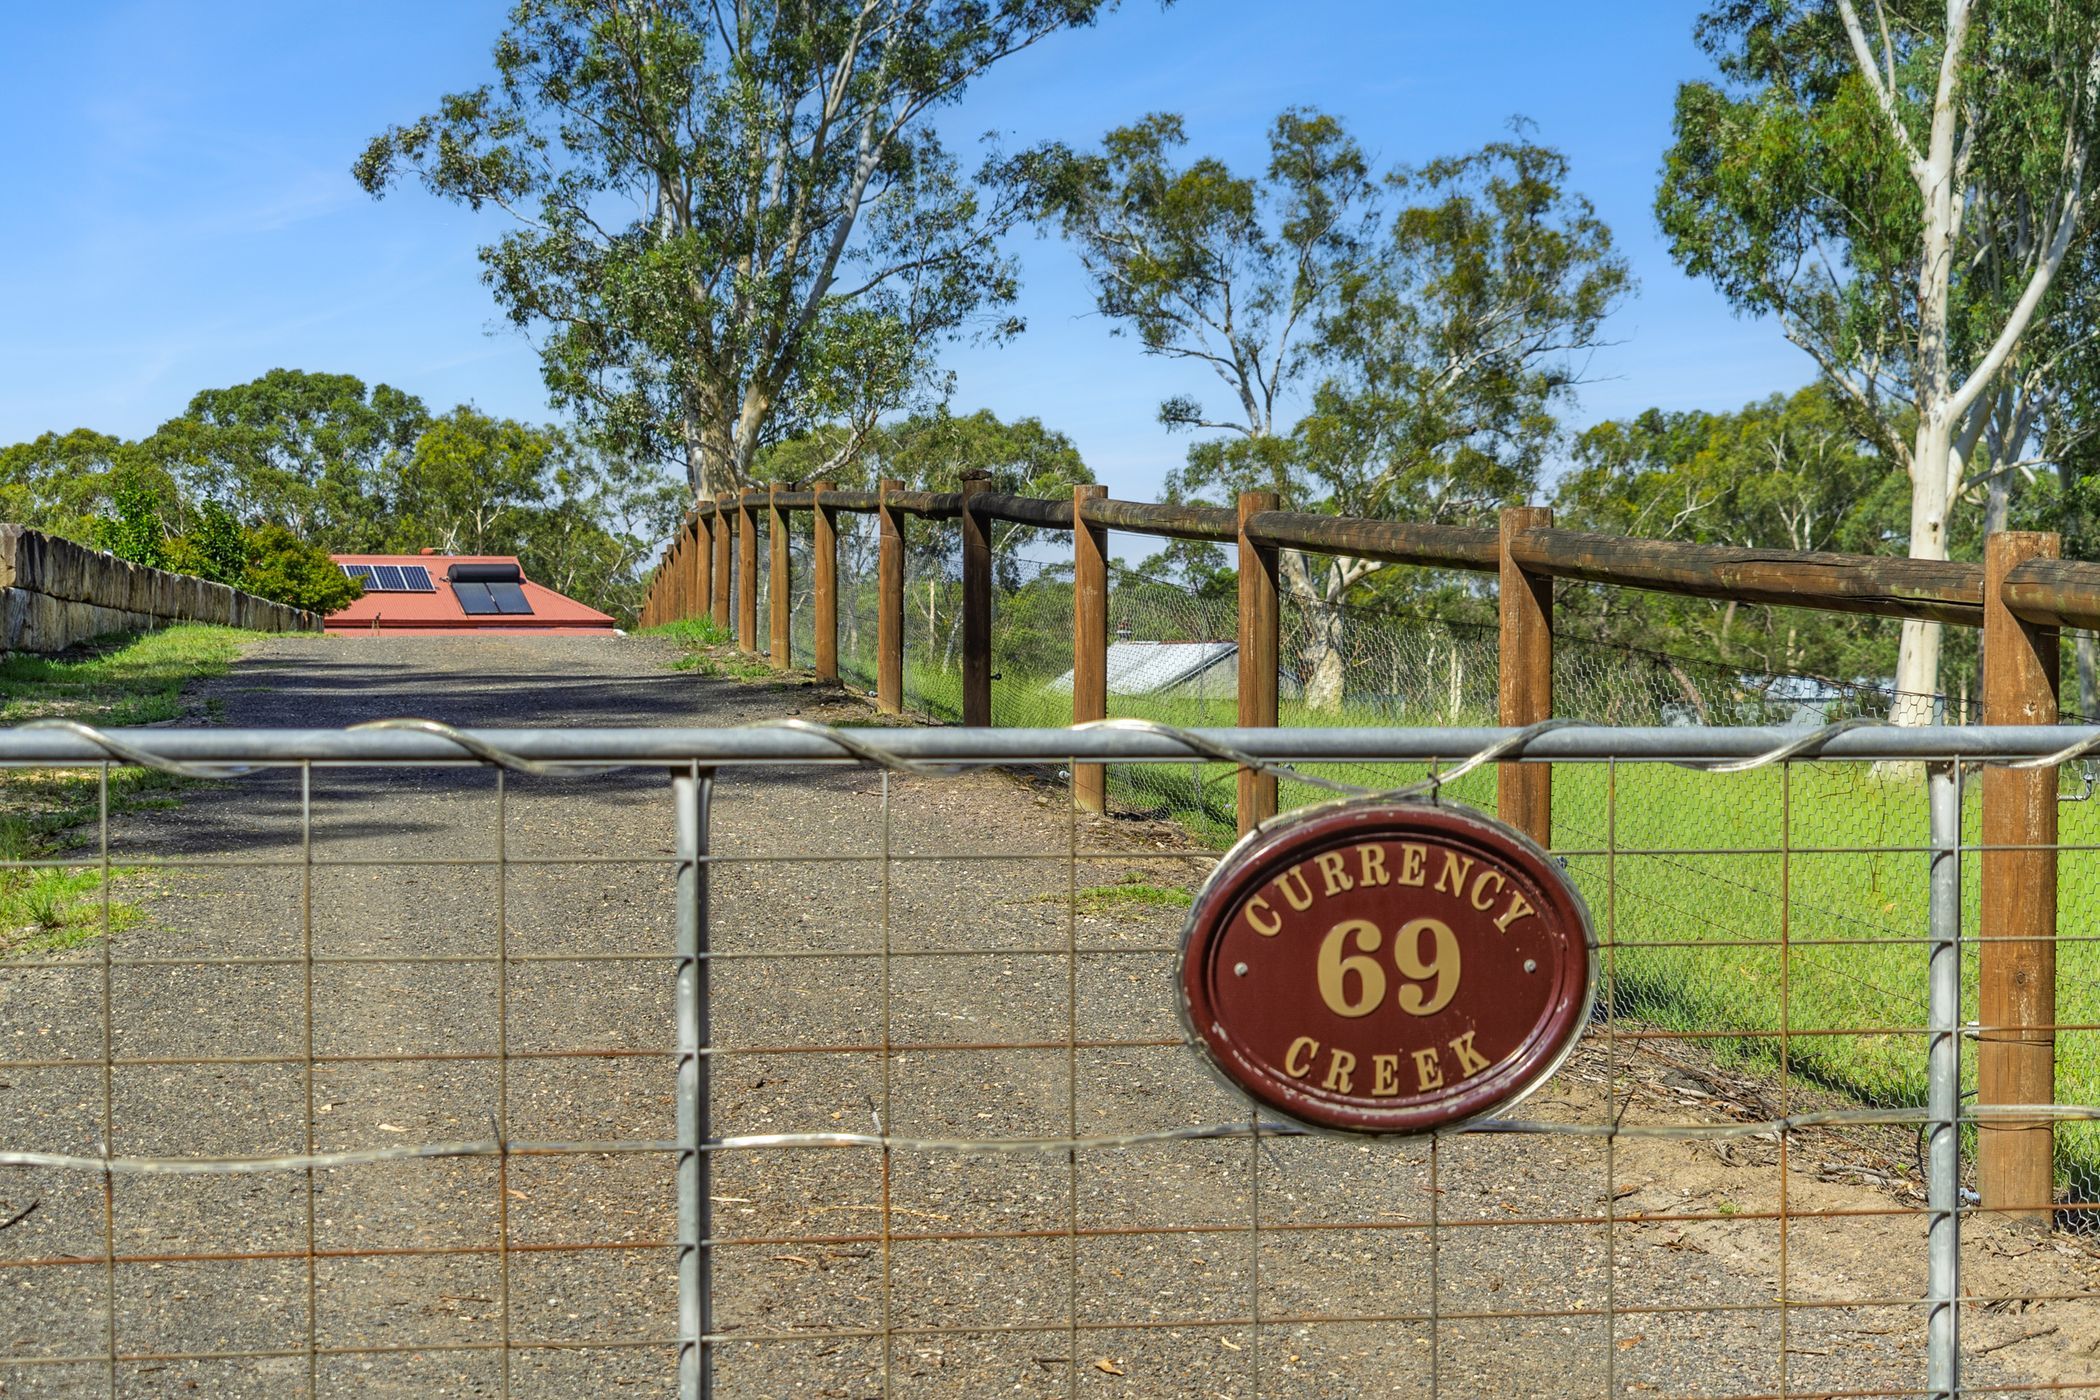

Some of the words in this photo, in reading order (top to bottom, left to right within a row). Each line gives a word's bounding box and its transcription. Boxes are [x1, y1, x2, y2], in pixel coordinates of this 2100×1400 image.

[1244, 842, 1535, 937] CURRENCY
[1316, 918, 1462, 1018] 69
[1285, 1030, 1491, 1096] CREEK
